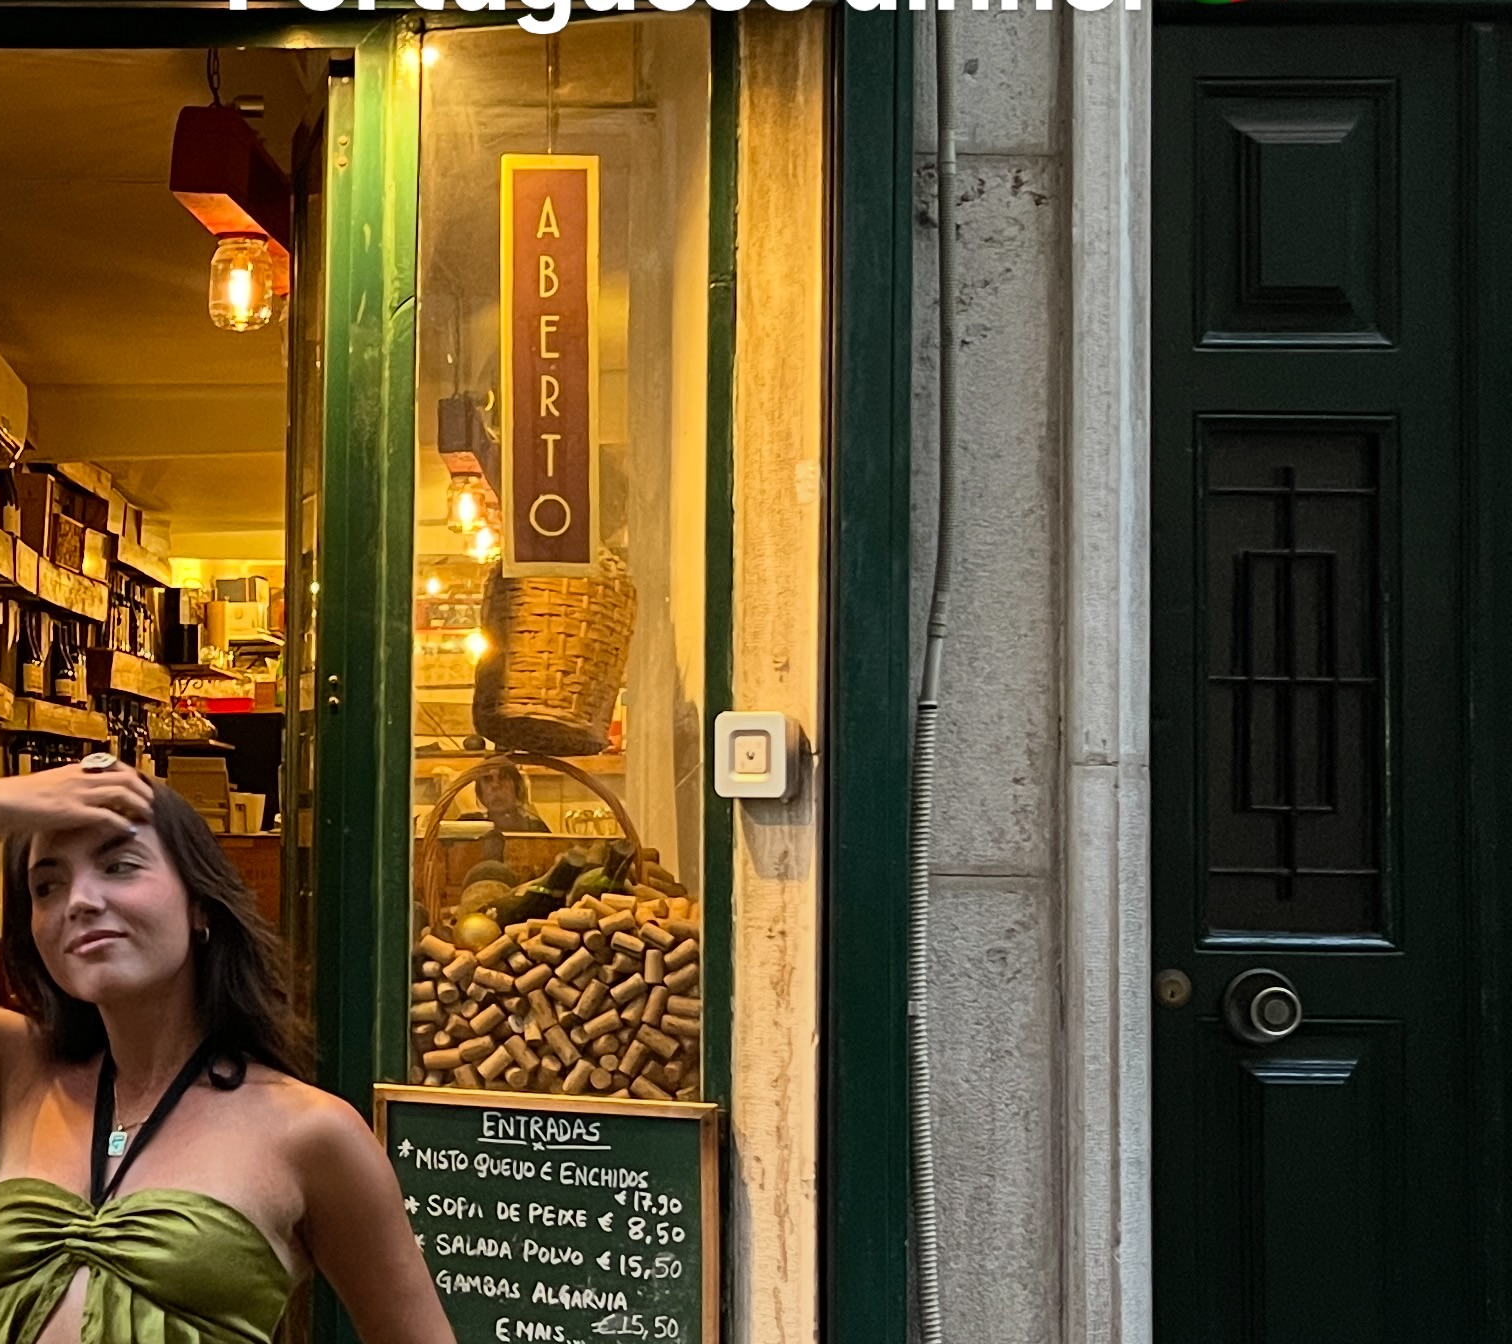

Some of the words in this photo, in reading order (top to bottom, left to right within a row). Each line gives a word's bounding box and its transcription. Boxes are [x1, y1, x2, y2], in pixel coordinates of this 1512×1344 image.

[529, 196, 571, 537] ABERTO
[482, 1111, 601, 1142] ENTRADAS
[560, 1162, 649, 1189] ENCHIDOS
[496, 1201, 521, 1222] DE
[528, 1203, 587, 1228] PEIXE
[436, 1233, 512, 1260] SALADA
[522, 1238, 584, 1266] POLVO
[435, 1269, 521, 1299] GAMBAS
[531, 1281, 628, 1311] ALGARVIA
